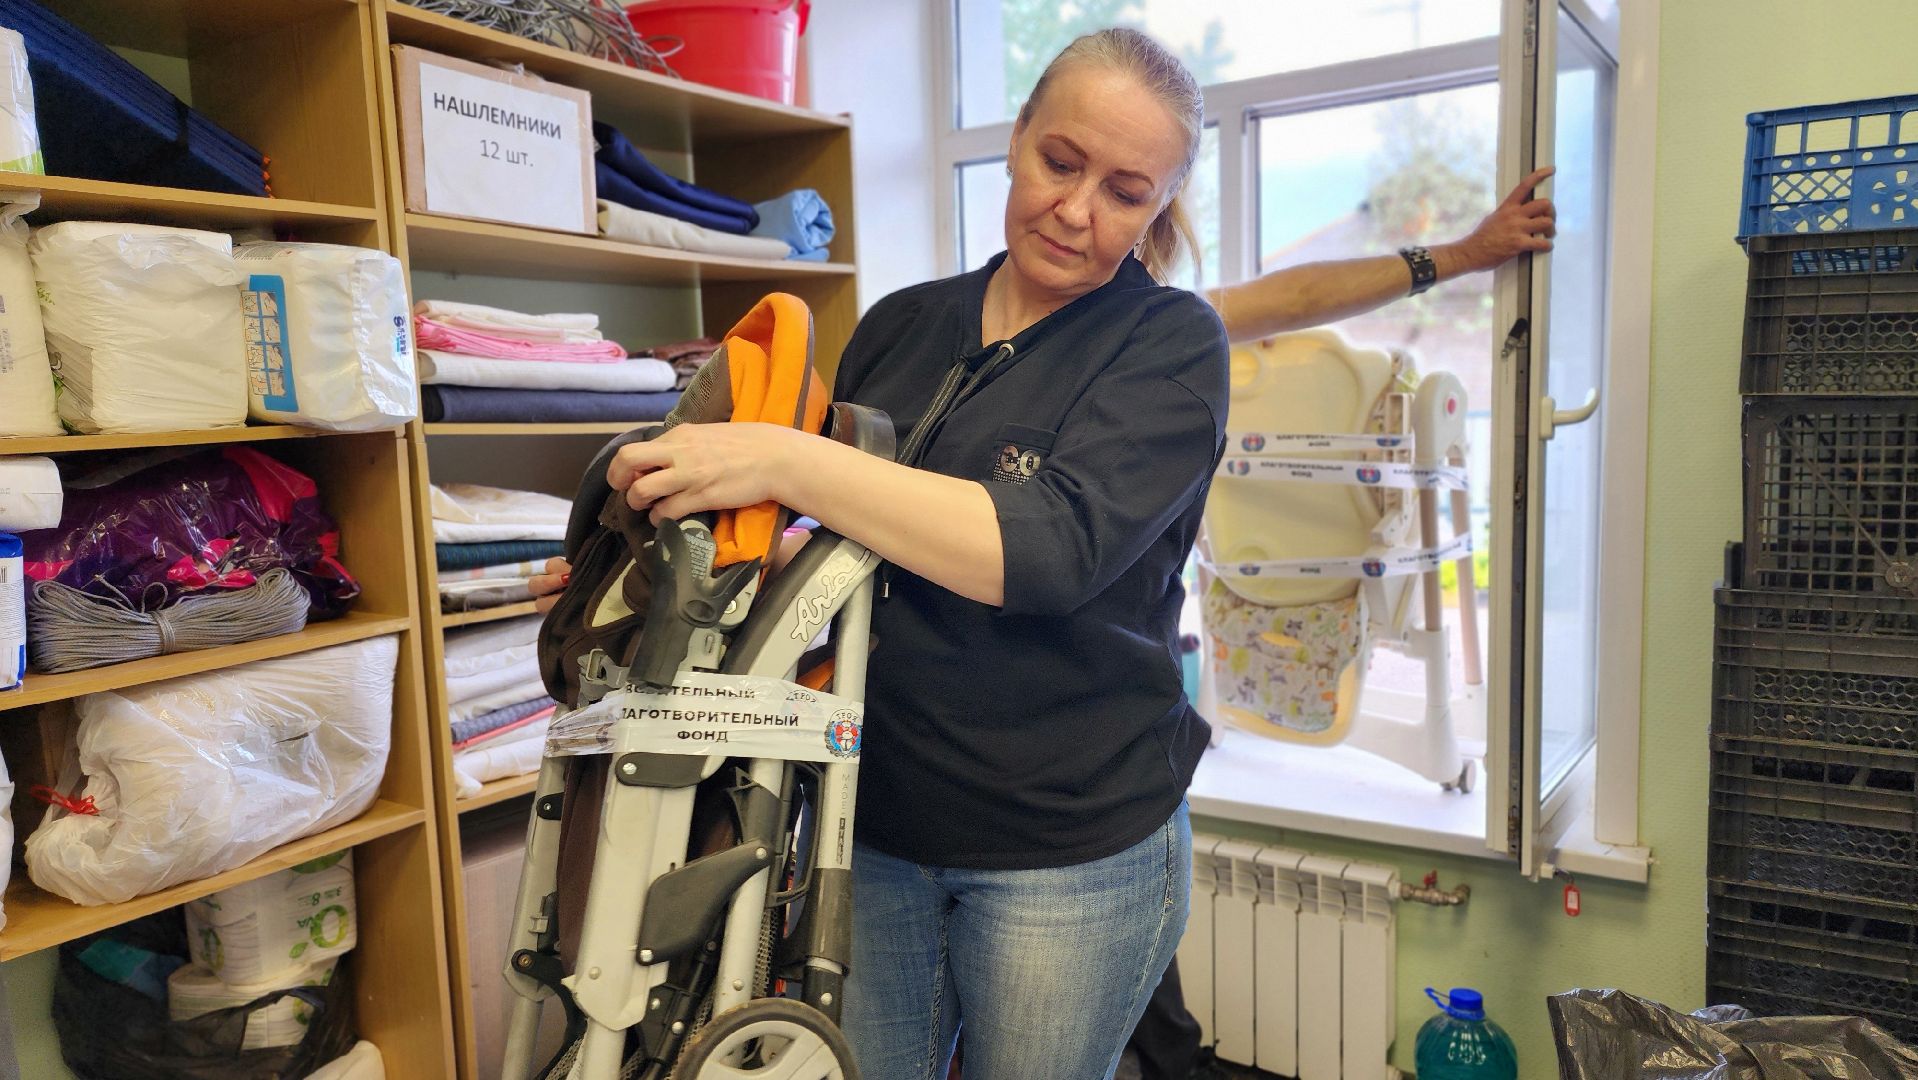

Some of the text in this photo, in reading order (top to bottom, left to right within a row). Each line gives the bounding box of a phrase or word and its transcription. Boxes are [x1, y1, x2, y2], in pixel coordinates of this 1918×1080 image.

[433, 92, 561, 139] НАШЛЕМНИКИ
[480, 139, 500, 160] 12
[677, 730, 728, 743] ФОНД
